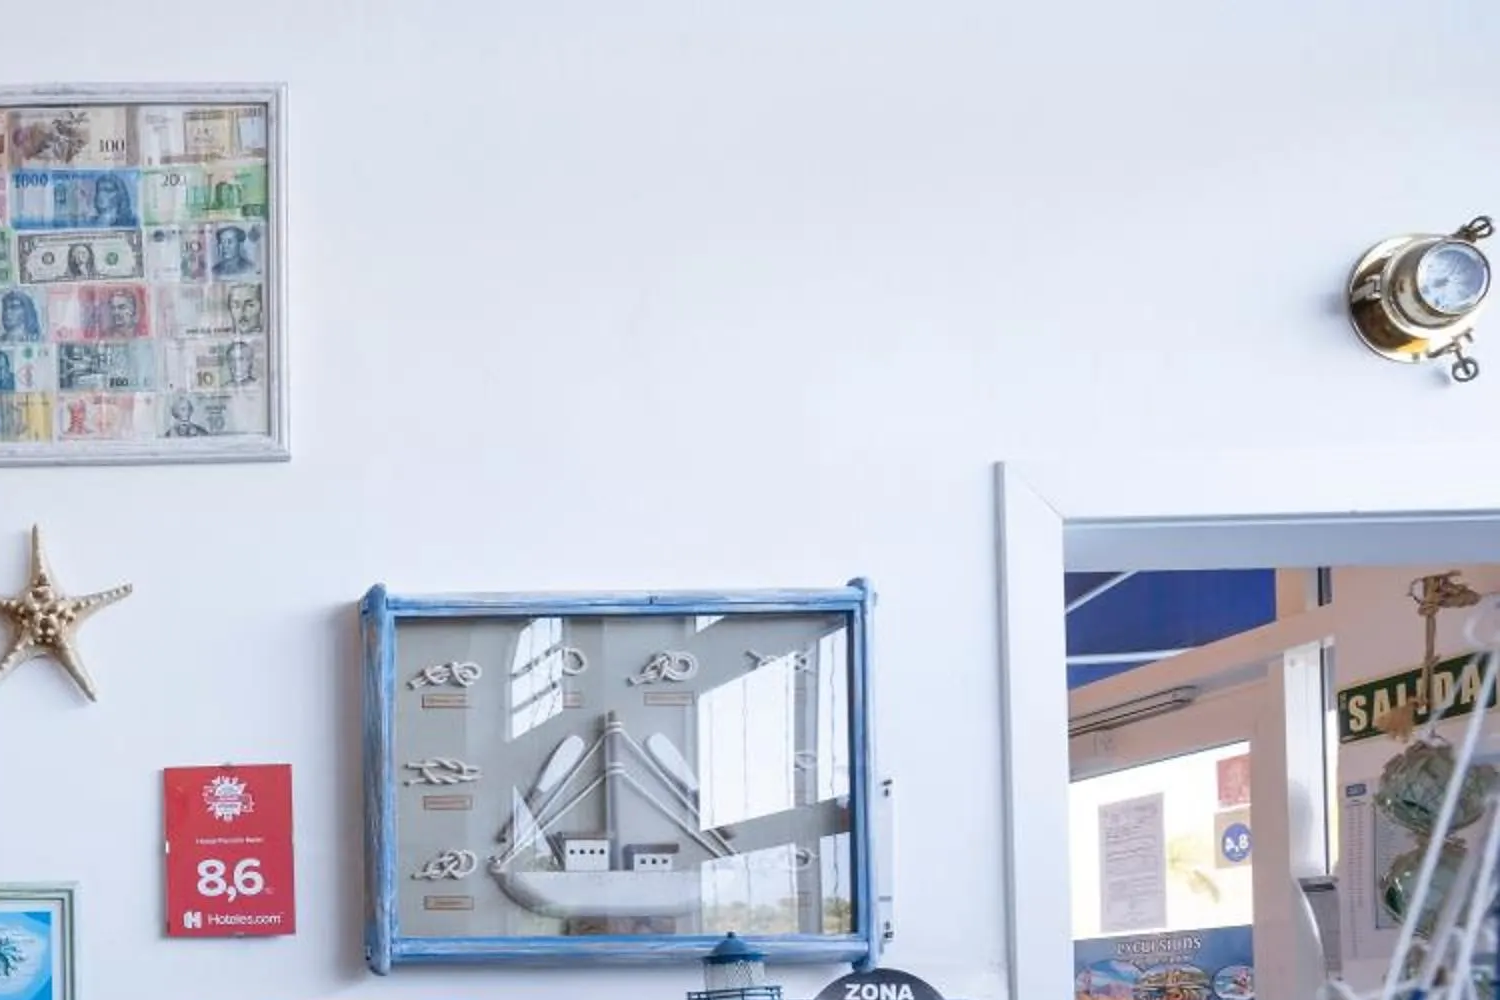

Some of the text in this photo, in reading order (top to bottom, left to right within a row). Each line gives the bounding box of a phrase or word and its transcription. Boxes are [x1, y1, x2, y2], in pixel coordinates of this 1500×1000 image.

[197, 371, 214, 386] 10
[197, 858, 264, 903] 8,6
[207, 913, 281, 925] Hoteles.com
[845, 984, 914, 1000] ZONA
